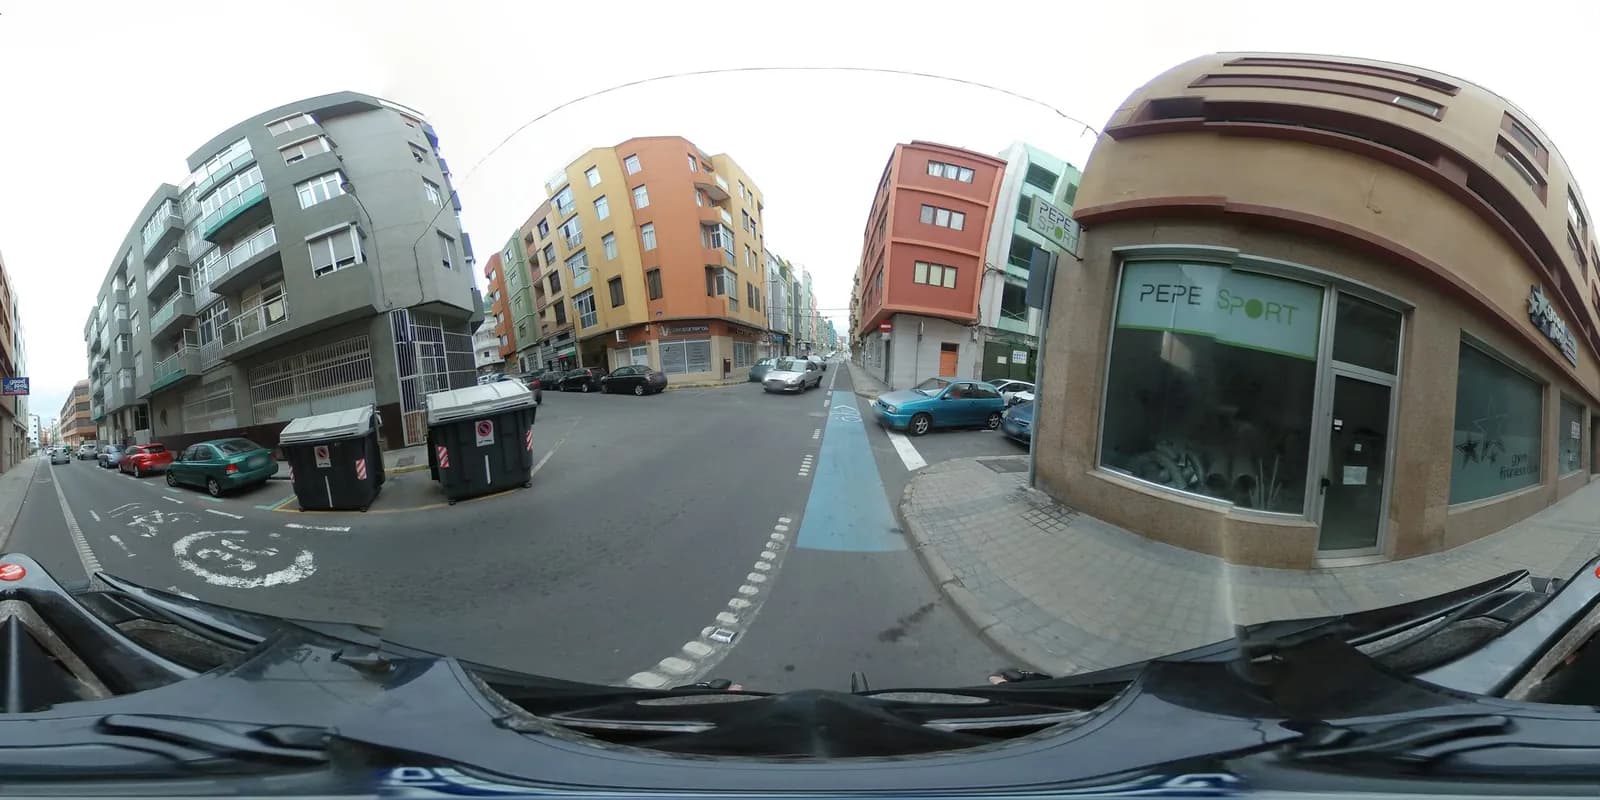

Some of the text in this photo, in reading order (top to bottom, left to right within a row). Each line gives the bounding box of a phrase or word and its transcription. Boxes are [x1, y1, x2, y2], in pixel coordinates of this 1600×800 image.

[1039, 215, 1078, 249] SPORT
[1040, 202, 1072, 232] PEPE
[1140, 284, 1298, 325] PEPE SPORT
